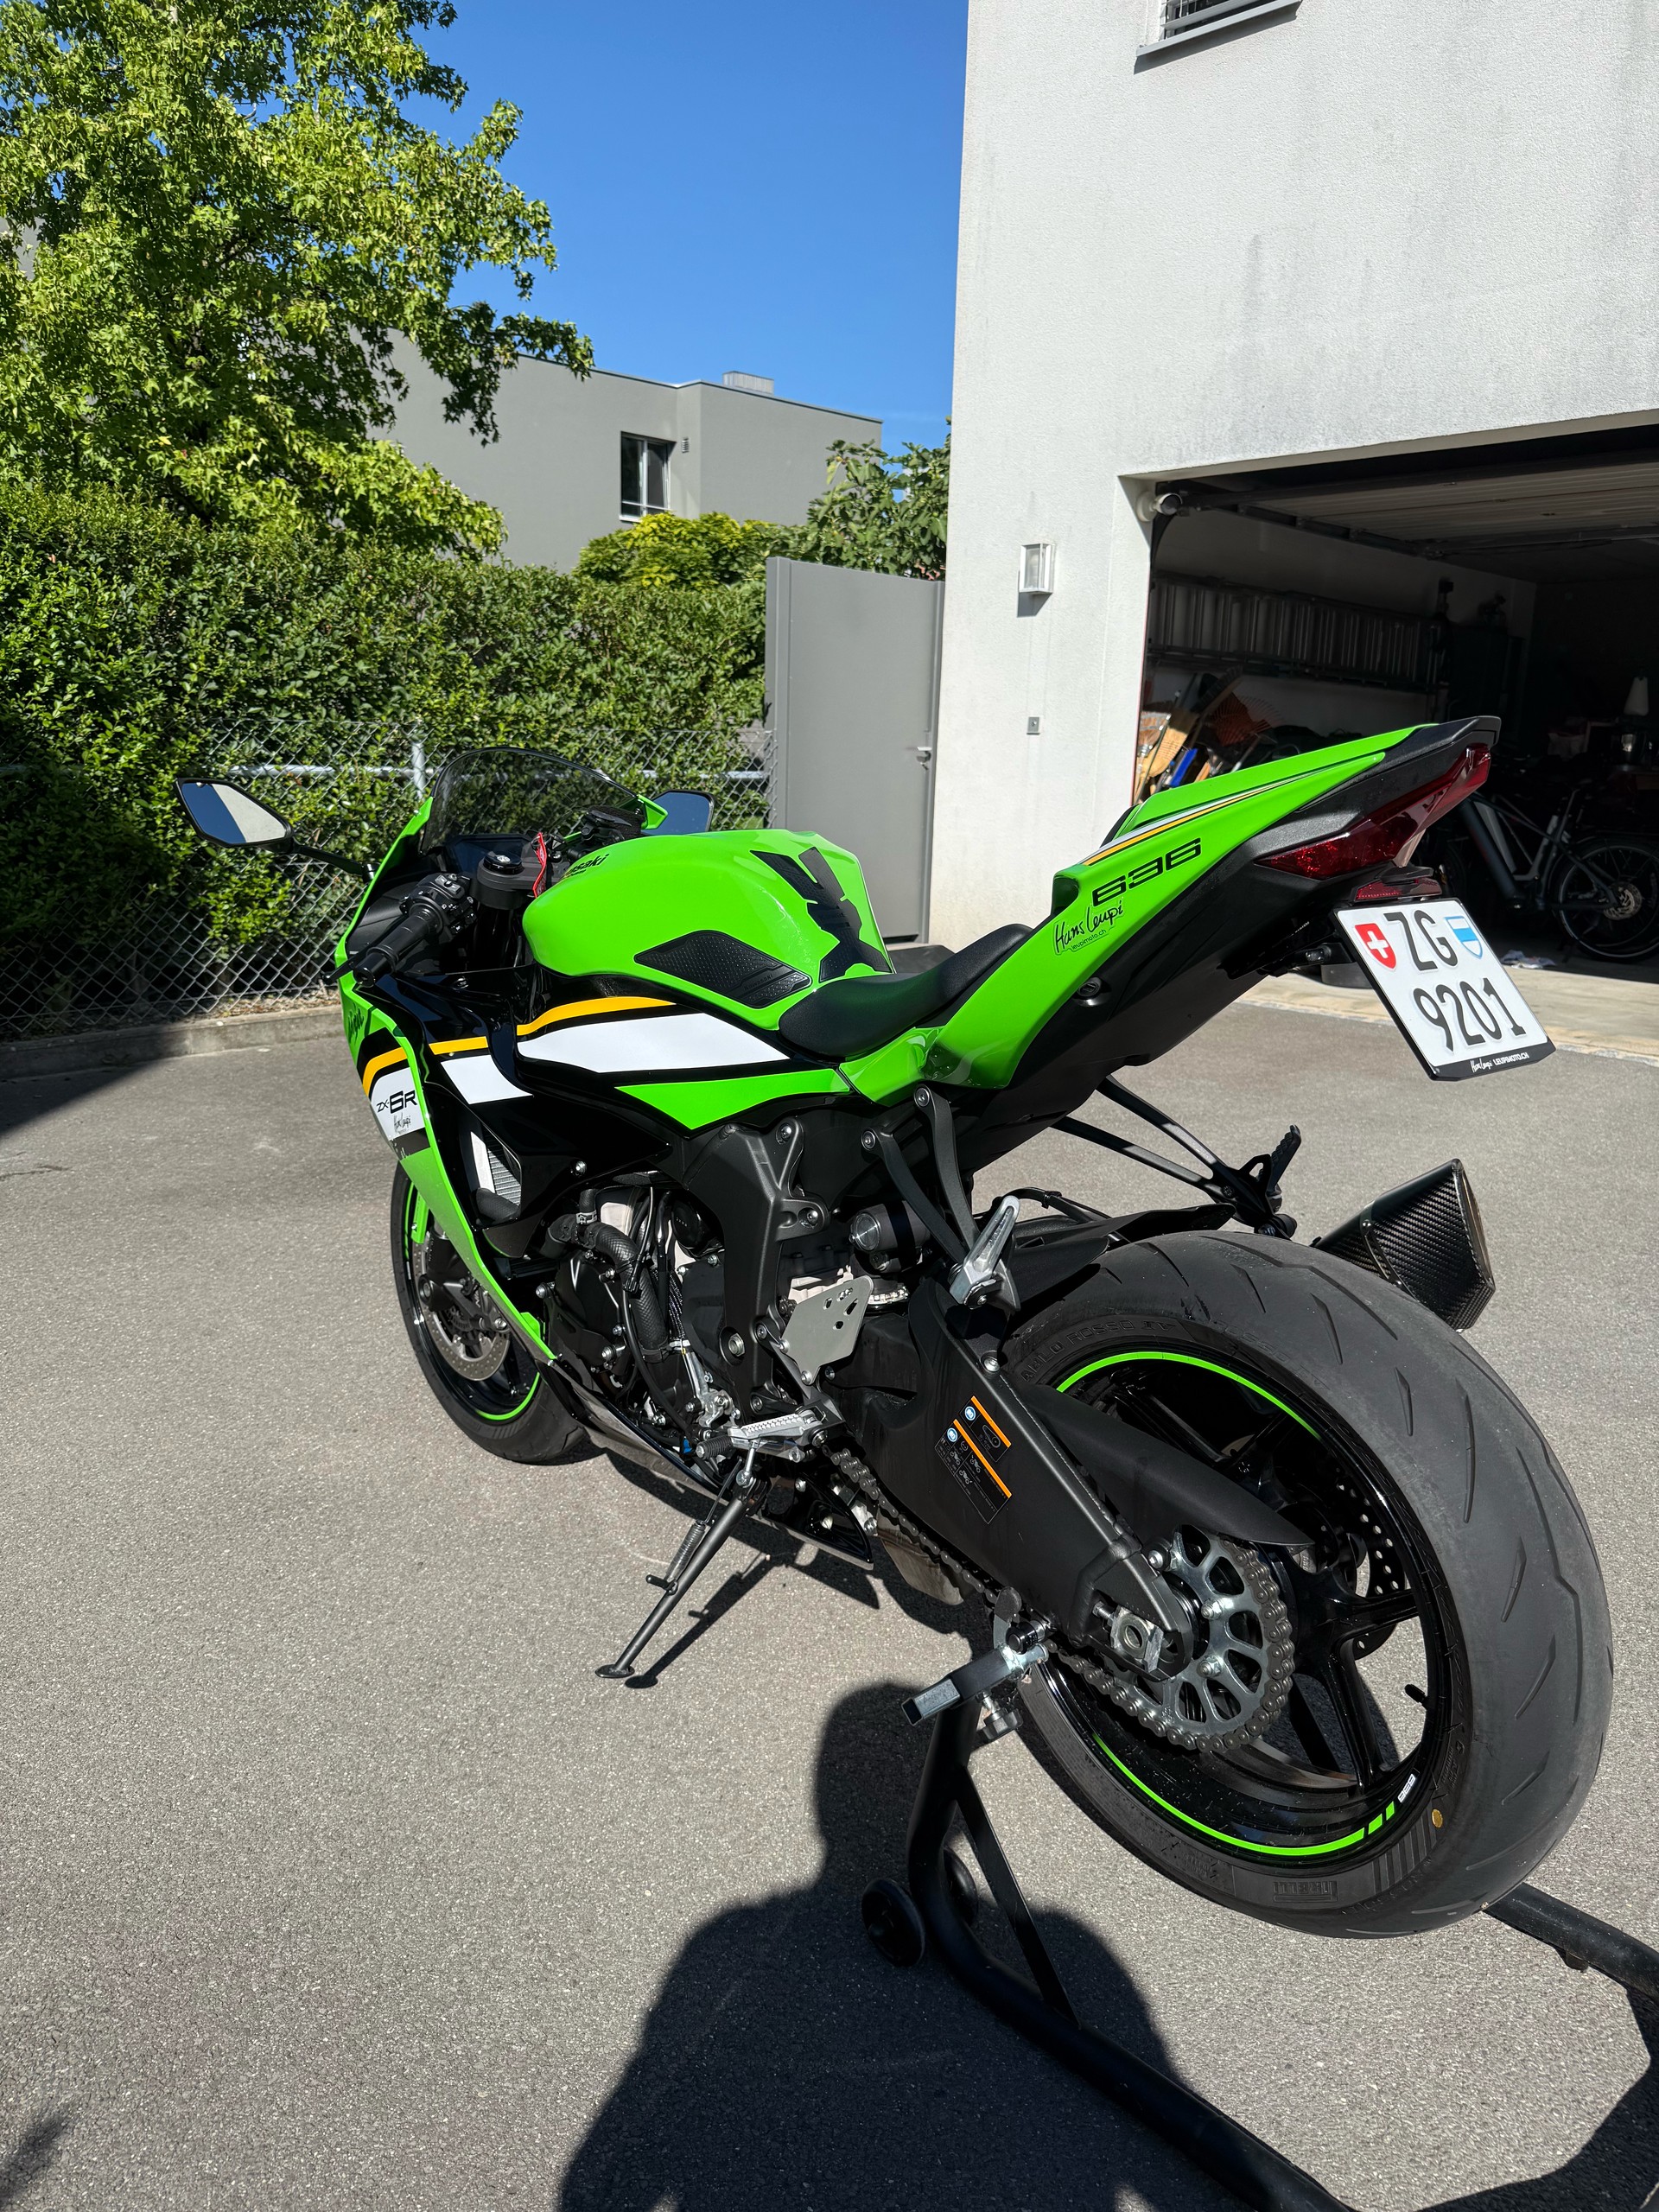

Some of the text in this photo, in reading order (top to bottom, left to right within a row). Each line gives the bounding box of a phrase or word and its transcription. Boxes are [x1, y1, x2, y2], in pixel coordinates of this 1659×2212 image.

[1091, 837, 1202, 907] 636
[1054, 899, 1123, 954] Hans Leupi
[1382, 909, 1459, 972] ZG
[1413, 977, 1527, 1052] 9201
[376, 1090, 418, 1115] ZX-6R
[1065, 1319, 1136, 1345] ROSSO
[1397, 1773, 1416, 1803] 636
